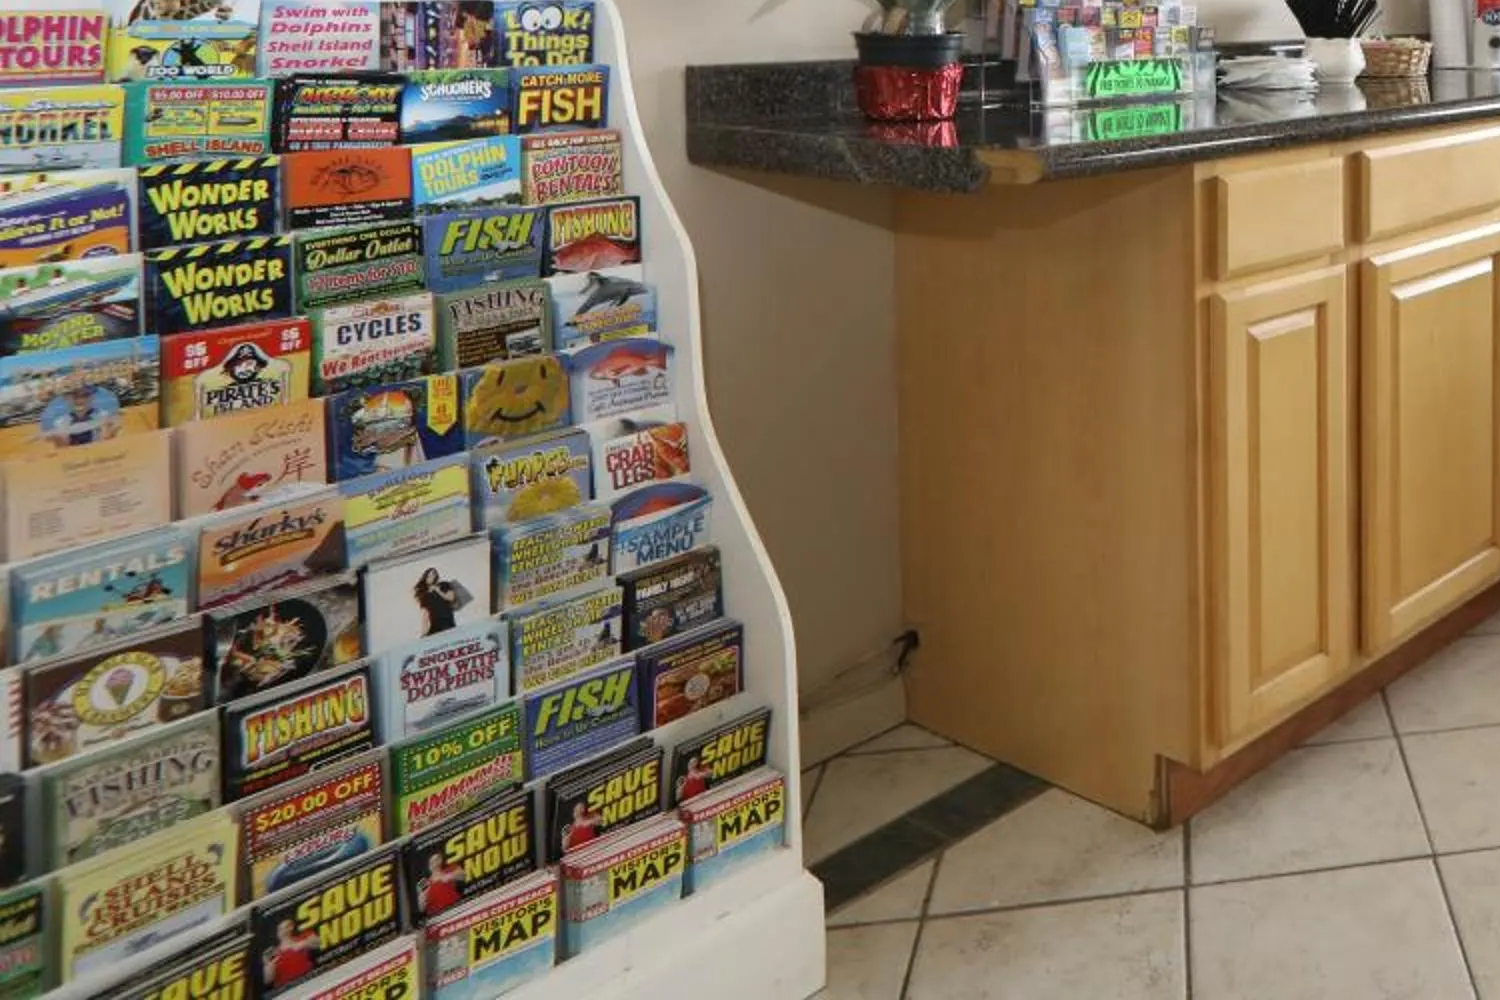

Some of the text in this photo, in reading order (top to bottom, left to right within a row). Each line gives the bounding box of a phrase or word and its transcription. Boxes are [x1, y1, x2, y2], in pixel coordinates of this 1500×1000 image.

[0, 15, 104, 43] LPHIN
[270, 22, 372, 36] Dolphins
[273, 5, 369, 18] Swim with
[0, 44, 103, 69] TOURS
[266, 39, 373, 53] Shell Island
[508, 32, 589, 53] Things
[271, 55, 368, 69] Snorkel
[520, 73, 563, 88] CATCH
[516, 87, 602, 127] FISH
[145, 138, 265, 157] SHELL ISLAND
[419, 143, 508, 182] DOLPHIN
[147, 178, 270, 216] WONDER
[166, 207, 259, 241] WORKS
[440, 211, 536, 255] FISH
[306, 237, 412, 271] Dollar Outlet
[161, 256, 285, 300] WONDER
[181, 288, 275, 325] WORKS
[336, 312, 423, 346] CYCLES
[321, 360, 347, 378] We
[626, 517, 705, 553] SAMPLE
[636, 535, 694, 566] MENU
[30, 547, 186, 604] RENTALS
[406, 667, 496, 702] DOLPHINS
[534, 667, 633, 737] FISH
[244, 677, 366, 763] FISHING
[414, 741, 464, 771] 10%
[468, 718, 513, 748] OFF
[701, 719, 766, 765] SAVE
[711, 741, 764, 780] NOW
[254, 789, 328, 834] $20.00
[334, 771, 375, 799] OFF
[587, 759, 659, 812] SAVE
[602, 785, 659, 828] NOW
[719, 789, 782, 823] VISITOR'S
[720, 799, 782, 843] MAP
[445, 805, 528, 866] SAVE
[463, 837, 530, 884] NOW
[610, 840, 683, 878] VISITOR'S
[612, 852, 682, 899] MAP
[296, 863, 394, 931] SAVE
[319, 893, 396, 952] NOW
[471, 898, 553, 935] VISITOR'S
[474, 910, 552, 961] MAP
[145, 951, 247, 1000] AVE
